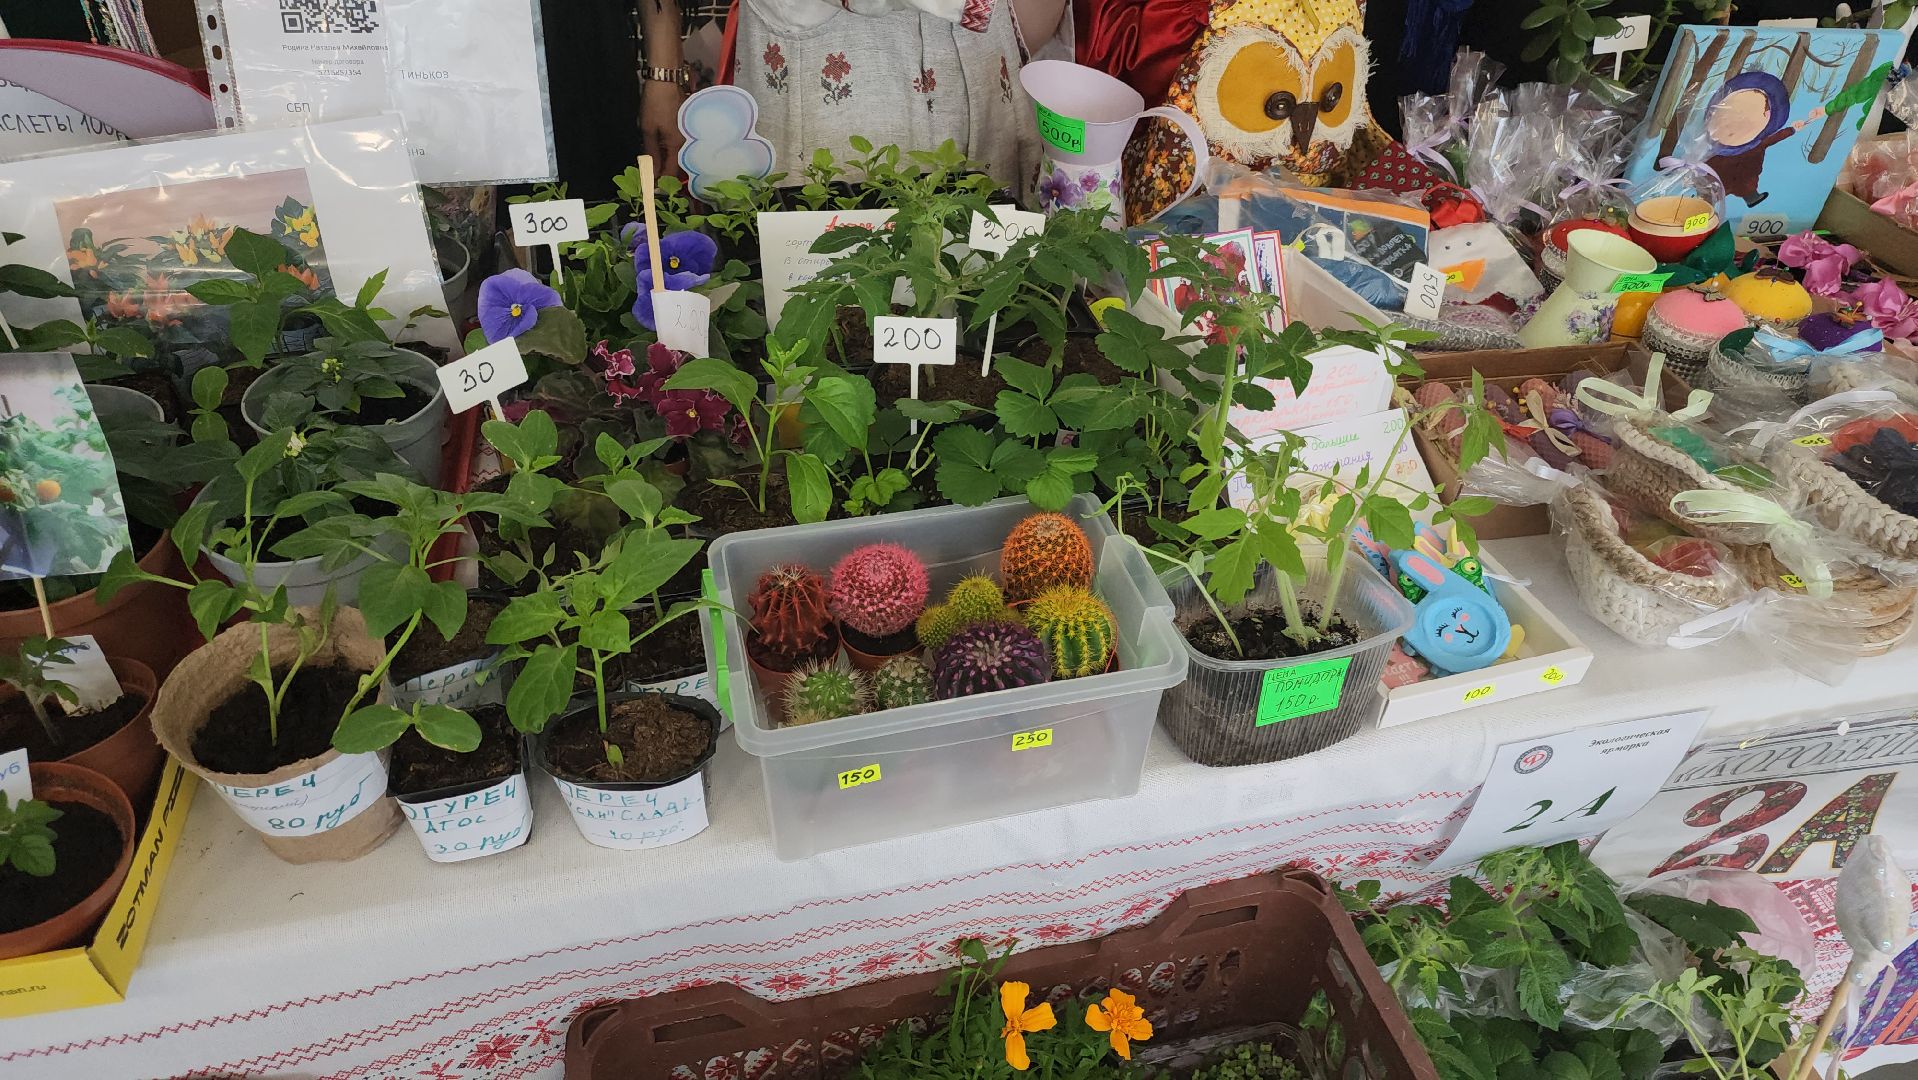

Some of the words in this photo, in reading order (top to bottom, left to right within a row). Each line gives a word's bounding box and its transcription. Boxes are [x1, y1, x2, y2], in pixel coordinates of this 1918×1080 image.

[286, 102, 311, 113] СБП
[524, 212, 568, 234] 300
[1746, 219, 1784, 235] 900
[1419, 272, 1439, 309] 500
[883, 327, 942, 351] 200
[458, 361, 495, 393] 30
[1463, 685, 1492, 701] 100
[1015, 732, 1048, 746] 250
[840, 768, 876, 785] 150
[268, 816, 306, 831] 80
[424, 815, 488, 834] АТОС
[434, 842, 469, 854] 30
